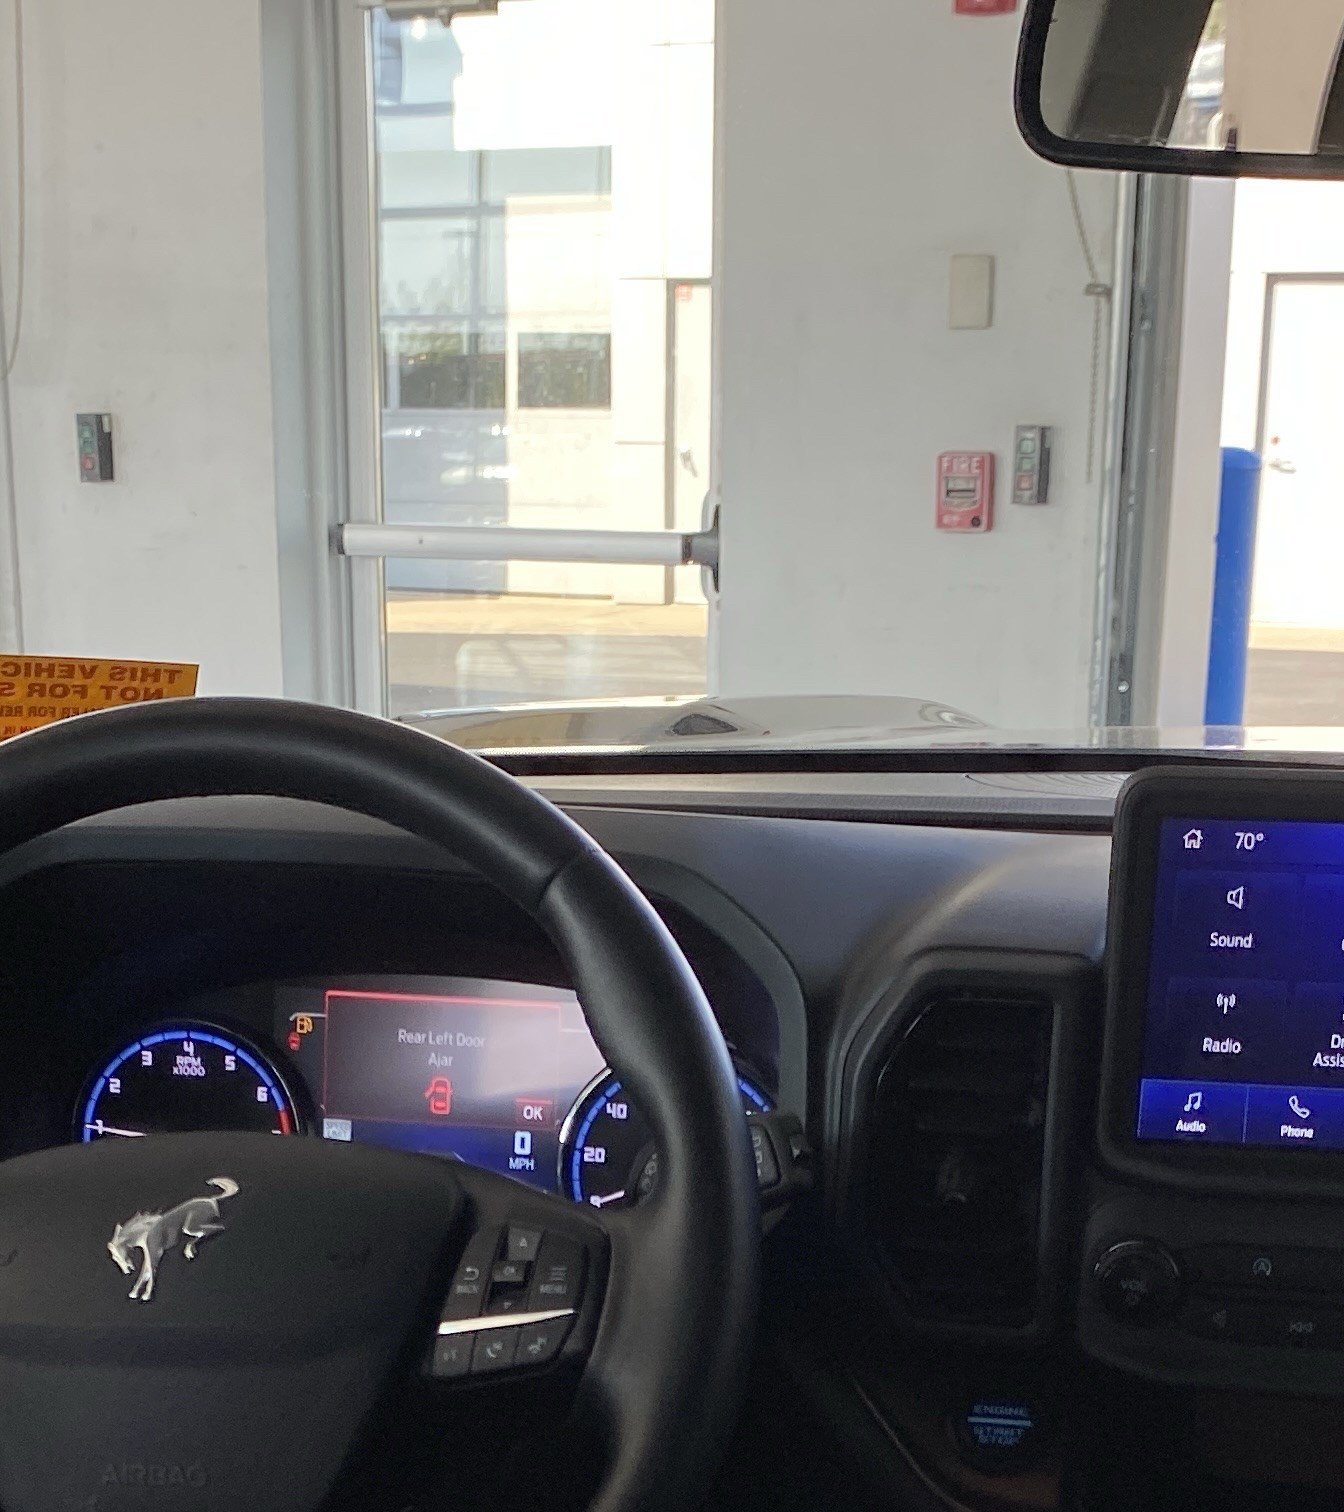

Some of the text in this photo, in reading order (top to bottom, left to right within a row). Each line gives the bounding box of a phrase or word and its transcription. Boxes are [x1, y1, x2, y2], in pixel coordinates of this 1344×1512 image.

[941, 456, 984, 474] FIRE
[1234, 832, 1264, 850] 70°
[1210, 931, 1254, 948] Sound
[398, 1028, 486, 1048] Rear Left Door
[1202, 1037, 1241, 1053] Radio
[182, 1041, 195, 1056] 4
[141, 1050, 153, 1067] 3
[175, 1055, 202, 1066] RPM
[224, 1055, 236, 1071] 5
[427, 1052, 453, 1068] Ajar
[108, 1077, 121, 1094] 2
[256, 1086, 268, 1102] 6
[522, 1105, 544, 1121] OK
[606, 1102, 628, 1120] 40
[1176, 1119, 1206, 1133] Audio
[1280, 1125, 1314, 1139] Phone
[513, 1130, 532, 1156] 0
[583, 1147, 606, 1164] 20
[508, 1157, 535, 1171] MPH
[100, 1461, 208, 1489] AIRBAG
